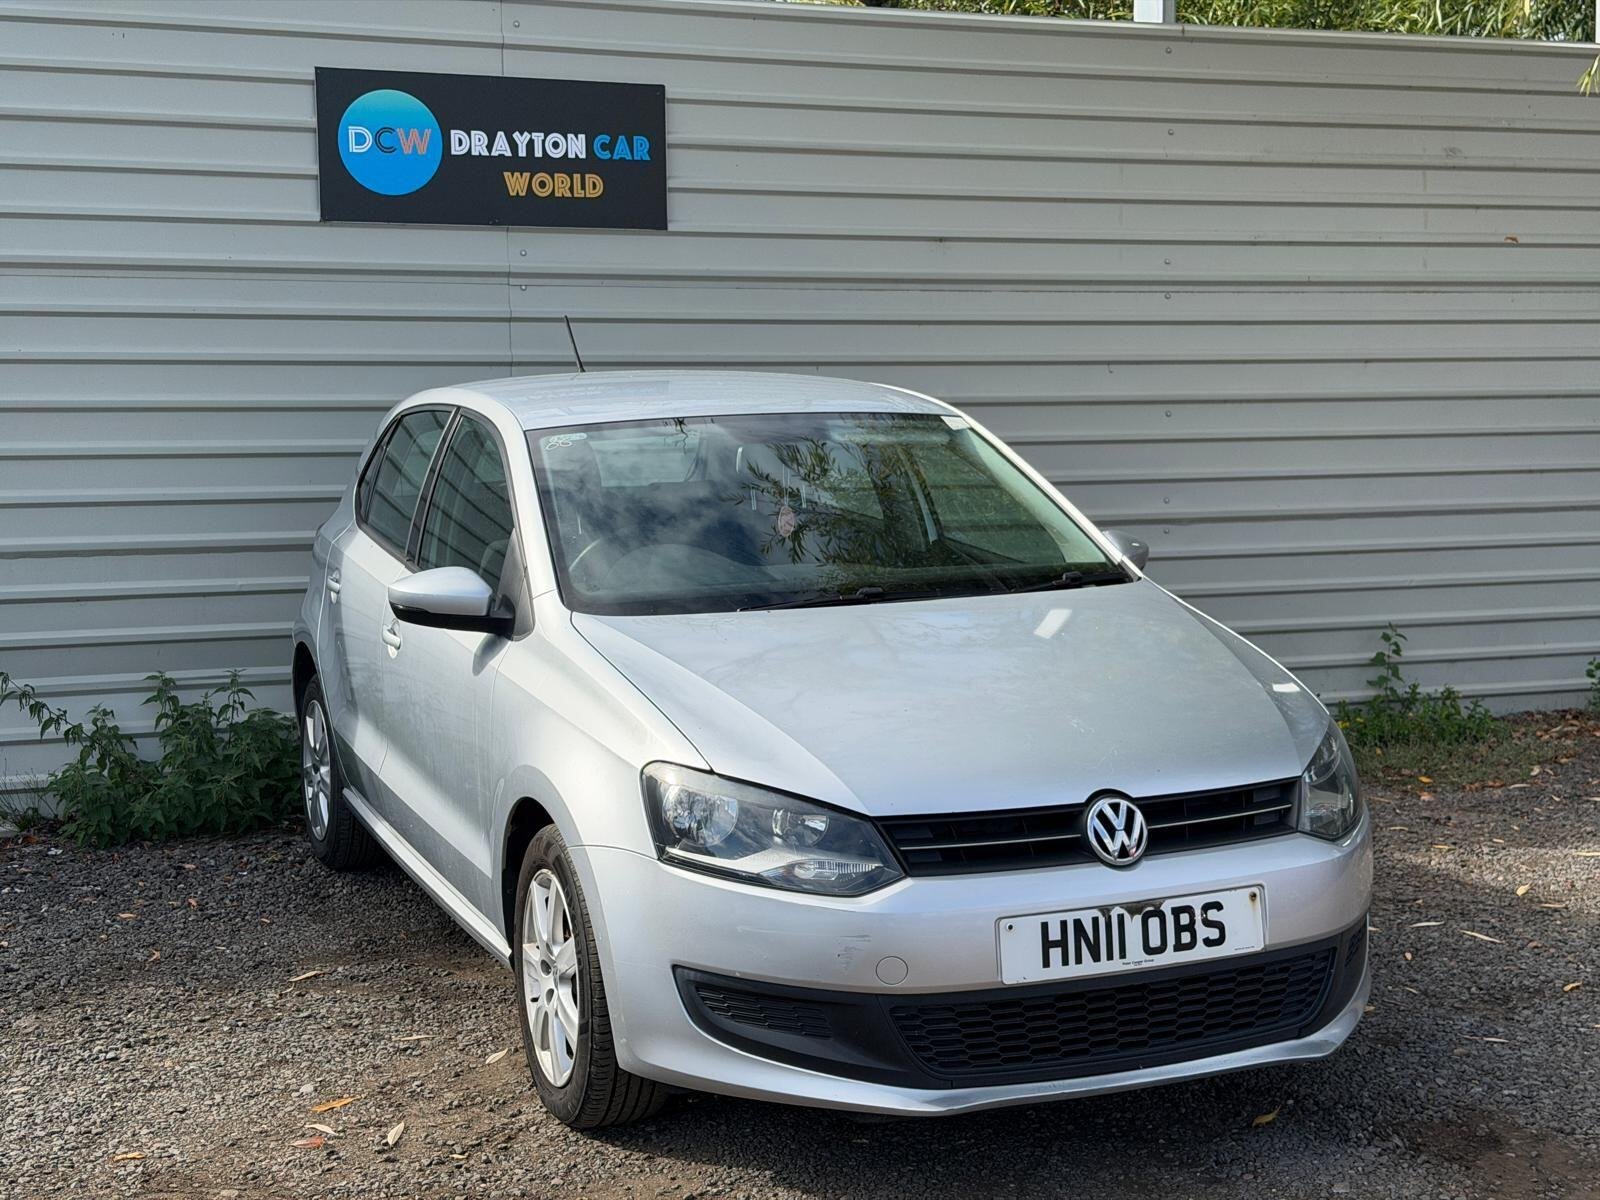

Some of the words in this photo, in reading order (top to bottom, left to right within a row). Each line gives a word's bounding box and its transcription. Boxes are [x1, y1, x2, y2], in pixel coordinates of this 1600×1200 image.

[348, 126, 431, 155] DCW
[450, 129, 586, 159] DRAYTON
[593, 135, 651, 161] CAR
[503, 171, 604, 198] WORLD
[1089, 799, 1145, 863] VW
[1040, 913, 1127, 968] HN11
[1140, 900, 1227, 956] OBS
